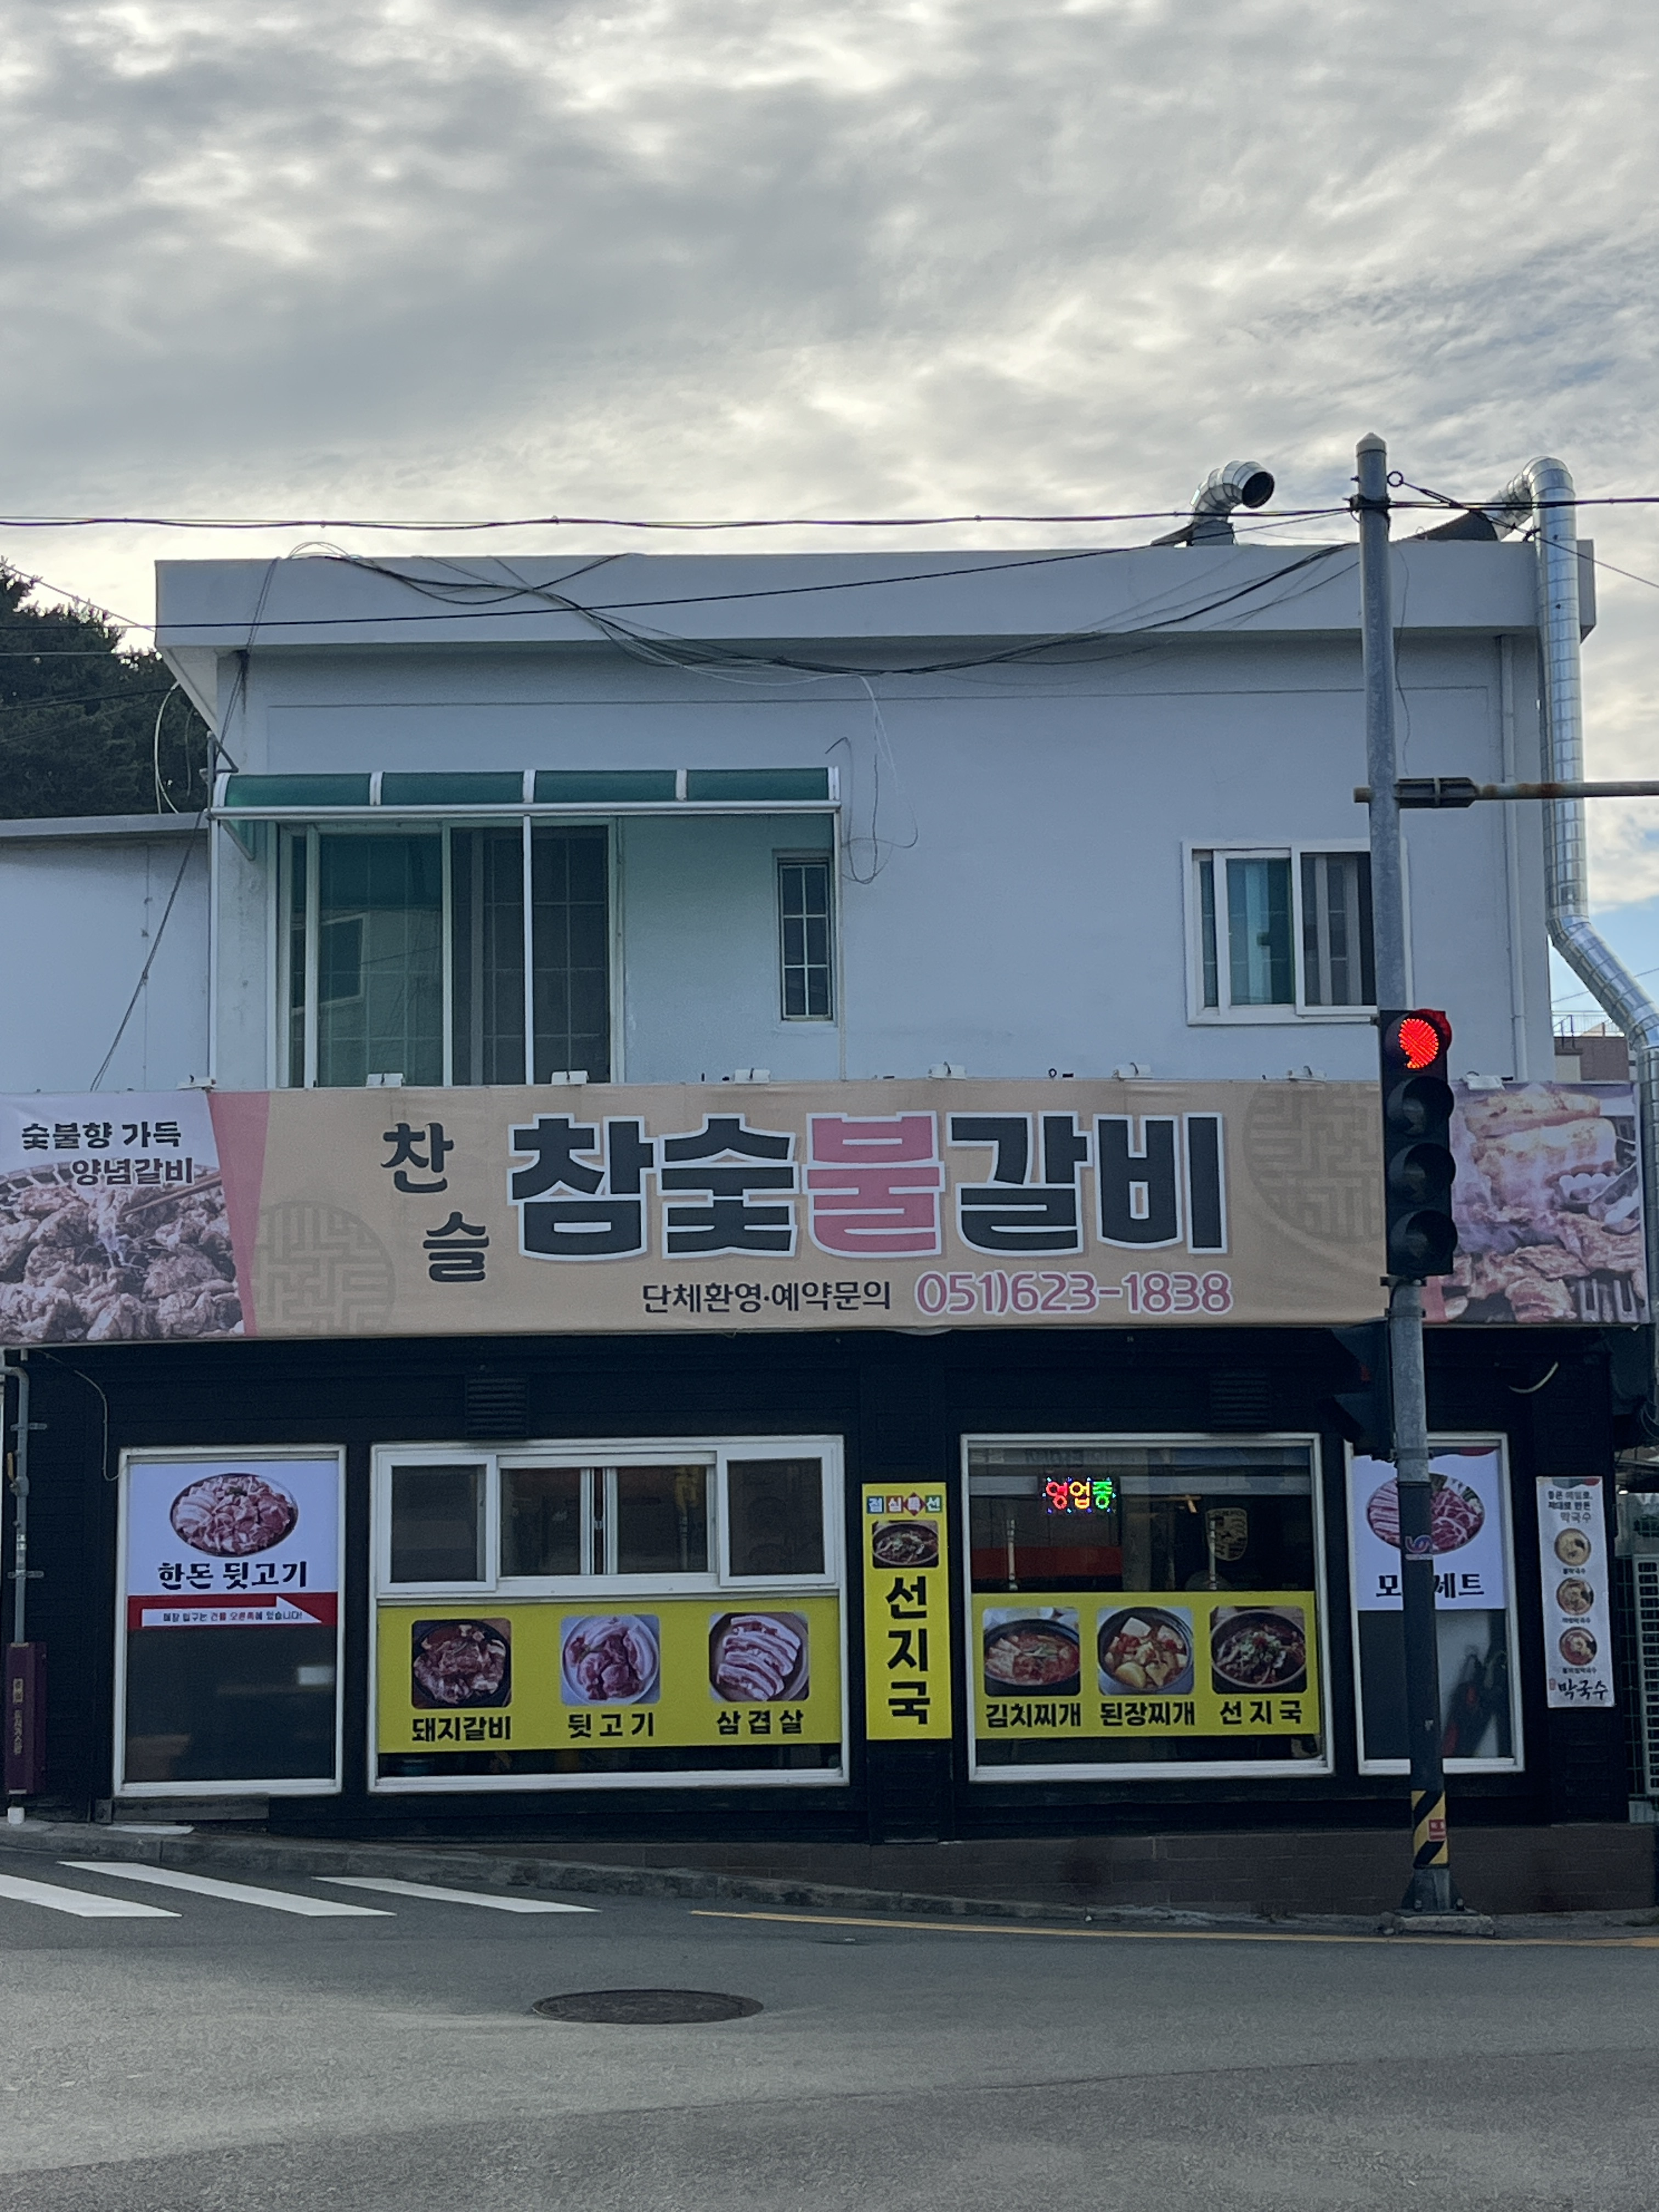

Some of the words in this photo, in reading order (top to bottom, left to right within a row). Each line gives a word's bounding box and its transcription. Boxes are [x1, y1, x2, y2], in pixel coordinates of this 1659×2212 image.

[22, 1122, 112, 1150] 숯불향
[122, 1121, 181, 1148] 가득
[72, 1157, 194, 1186] 양념갈비
[508, 1111, 1228, 1260] 참숯불갈비
[915, 1271, 1232, 1314] 051)623-1838
[1046, 1481, 1112, 1509] 영업중
[159, 1562, 213, 1590] 한돈
[223, 1561, 307, 1590] 뒷고기
[1376, 1572, 1485, 1598] 모세트
[886, 1576, 930, 1724] 선지국
[1558, 1678, 1609, 1701] 막국수
[412, 1716, 511, 1742] 돼지갈비
[568, 1712, 654, 1739] 뒷고기
[716, 1709, 804, 1736] 삼겹살
[986, 1702, 1081, 1728] 김치찌개
[1100, 1701, 1195, 1726] 된장찌개
[1220, 1700, 1302, 1725] 선지국
